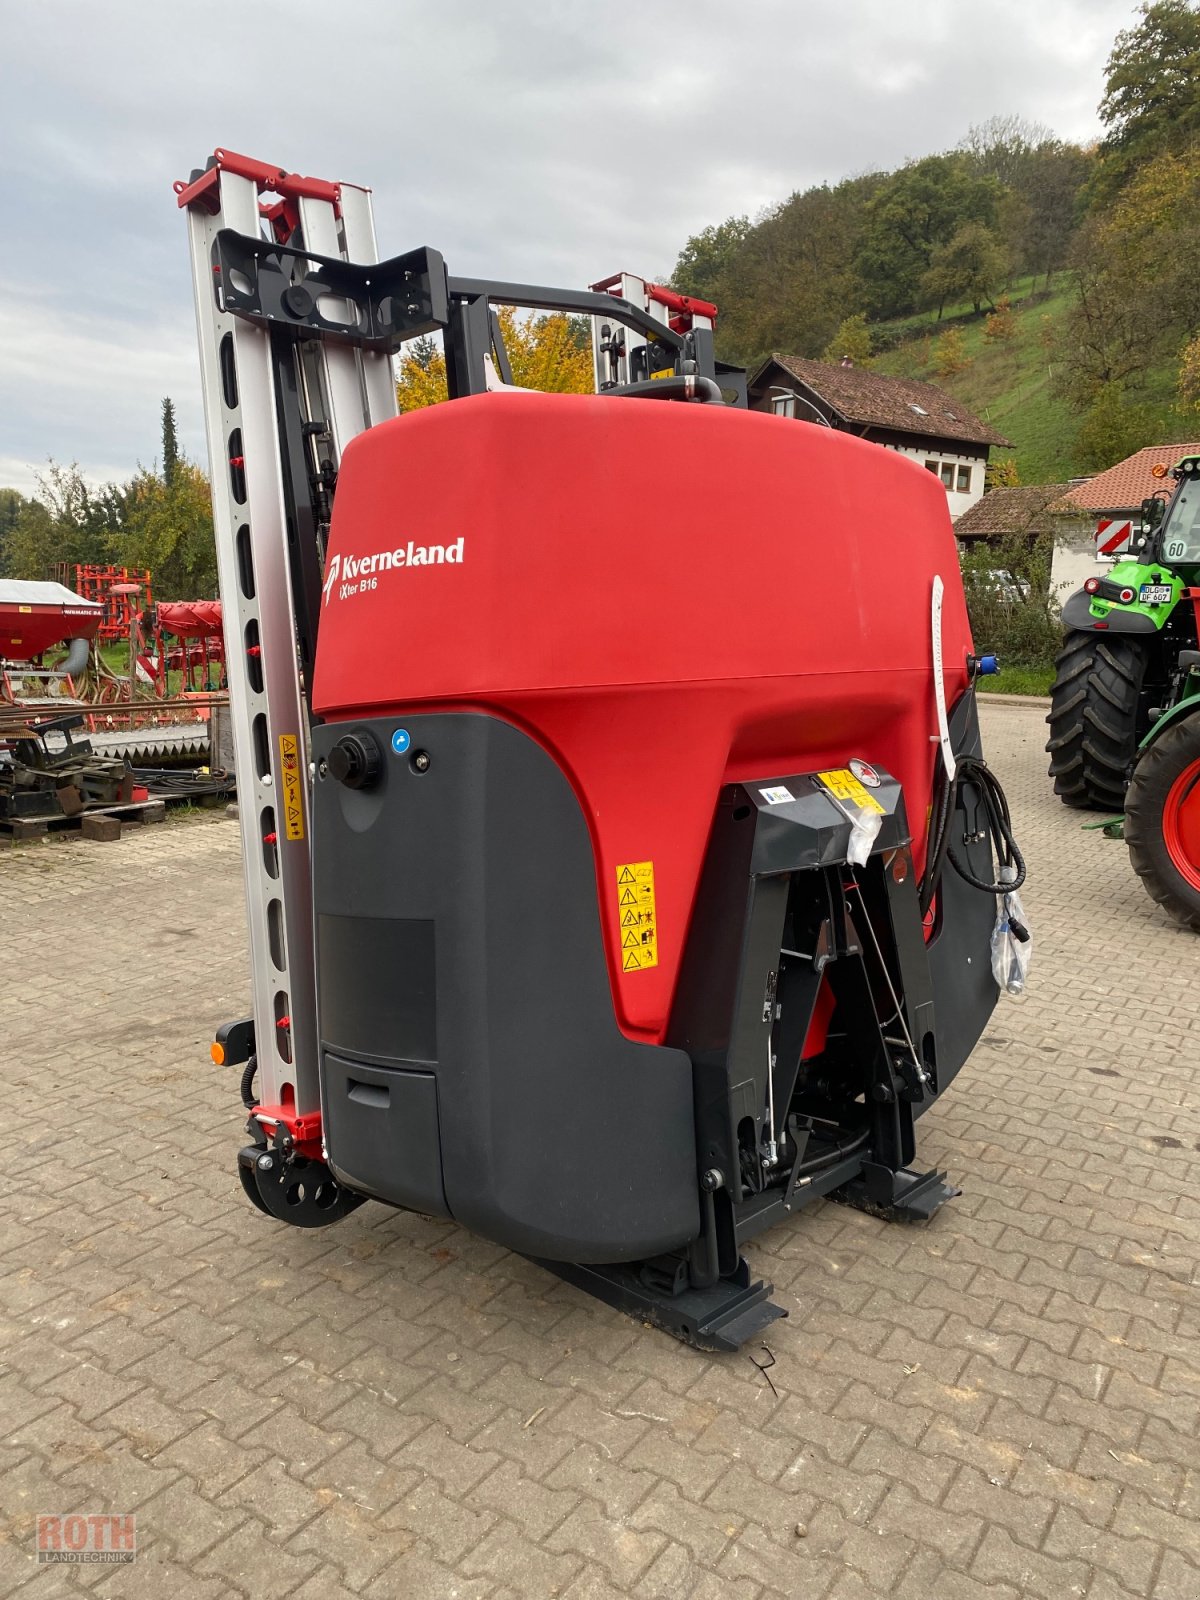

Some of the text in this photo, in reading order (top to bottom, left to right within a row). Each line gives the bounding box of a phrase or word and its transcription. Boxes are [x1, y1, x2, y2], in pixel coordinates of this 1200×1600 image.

[342, 537, 464, 581] Kverneland
[1168, 542, 1184, 557] 60
[339, 577, 377, 600] iXter B16
